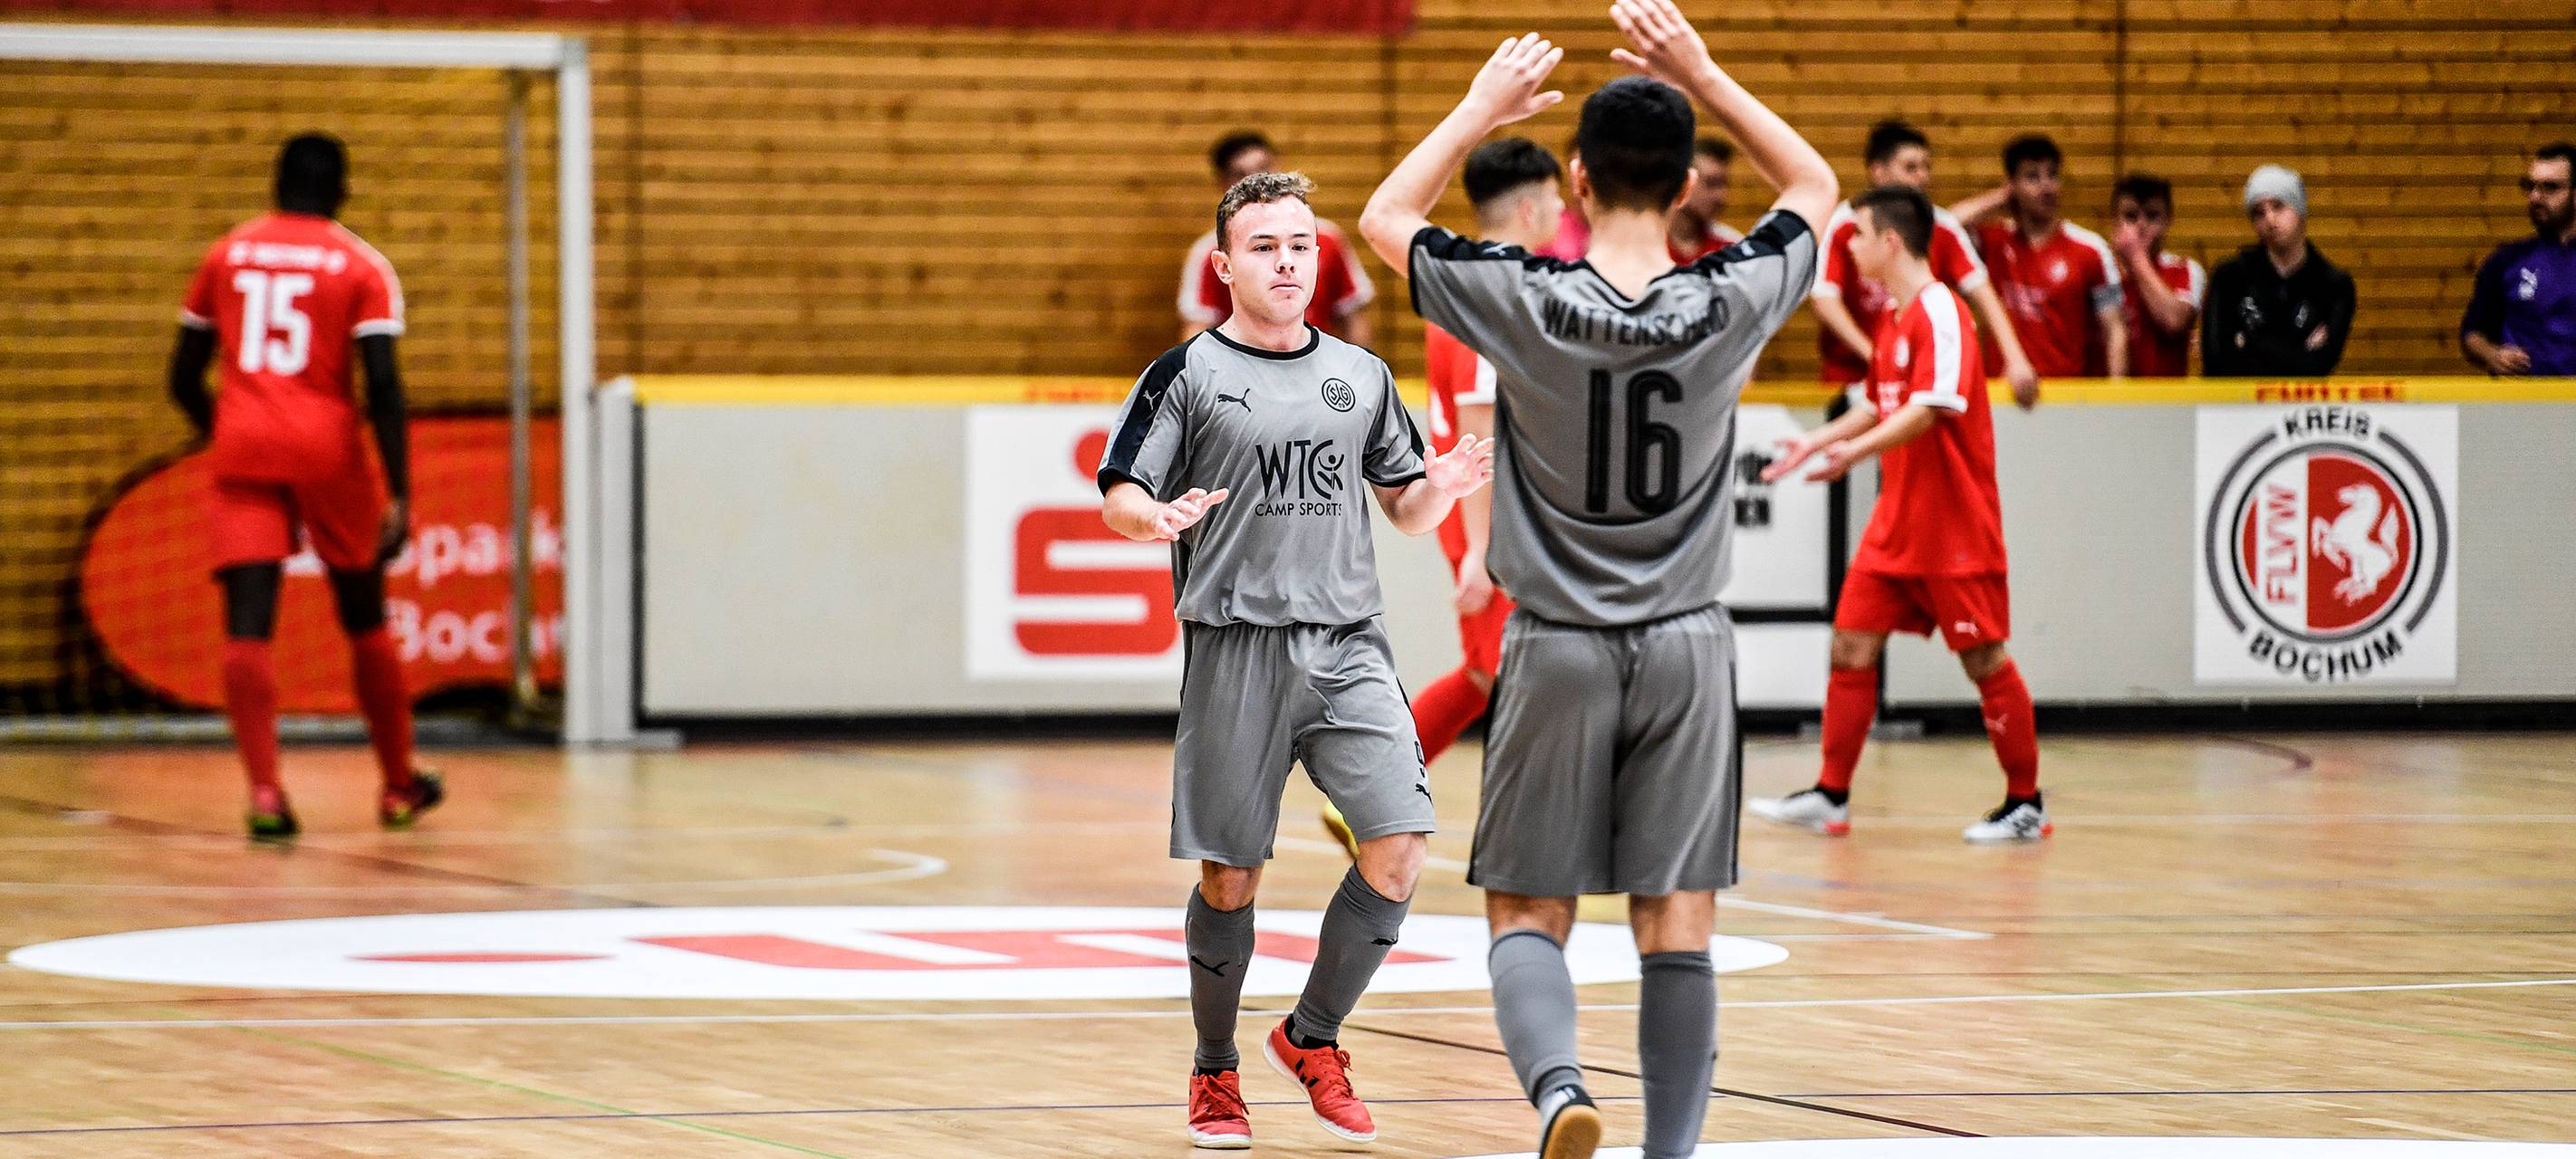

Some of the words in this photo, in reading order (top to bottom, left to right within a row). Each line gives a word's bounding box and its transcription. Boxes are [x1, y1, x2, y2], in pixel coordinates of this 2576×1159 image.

[234, 269, 315, 377] 15
[1587, 369, 1683, 513] 16
[2284, 407, 2372, 439] KREIS
[1255, 440, 1334, 500] WTC
[1254, 503, 1294, 516] CAMP
[2266, 484, 2299, 605] FLVW
[2248, 631, 2403, 681] BOCHUM
